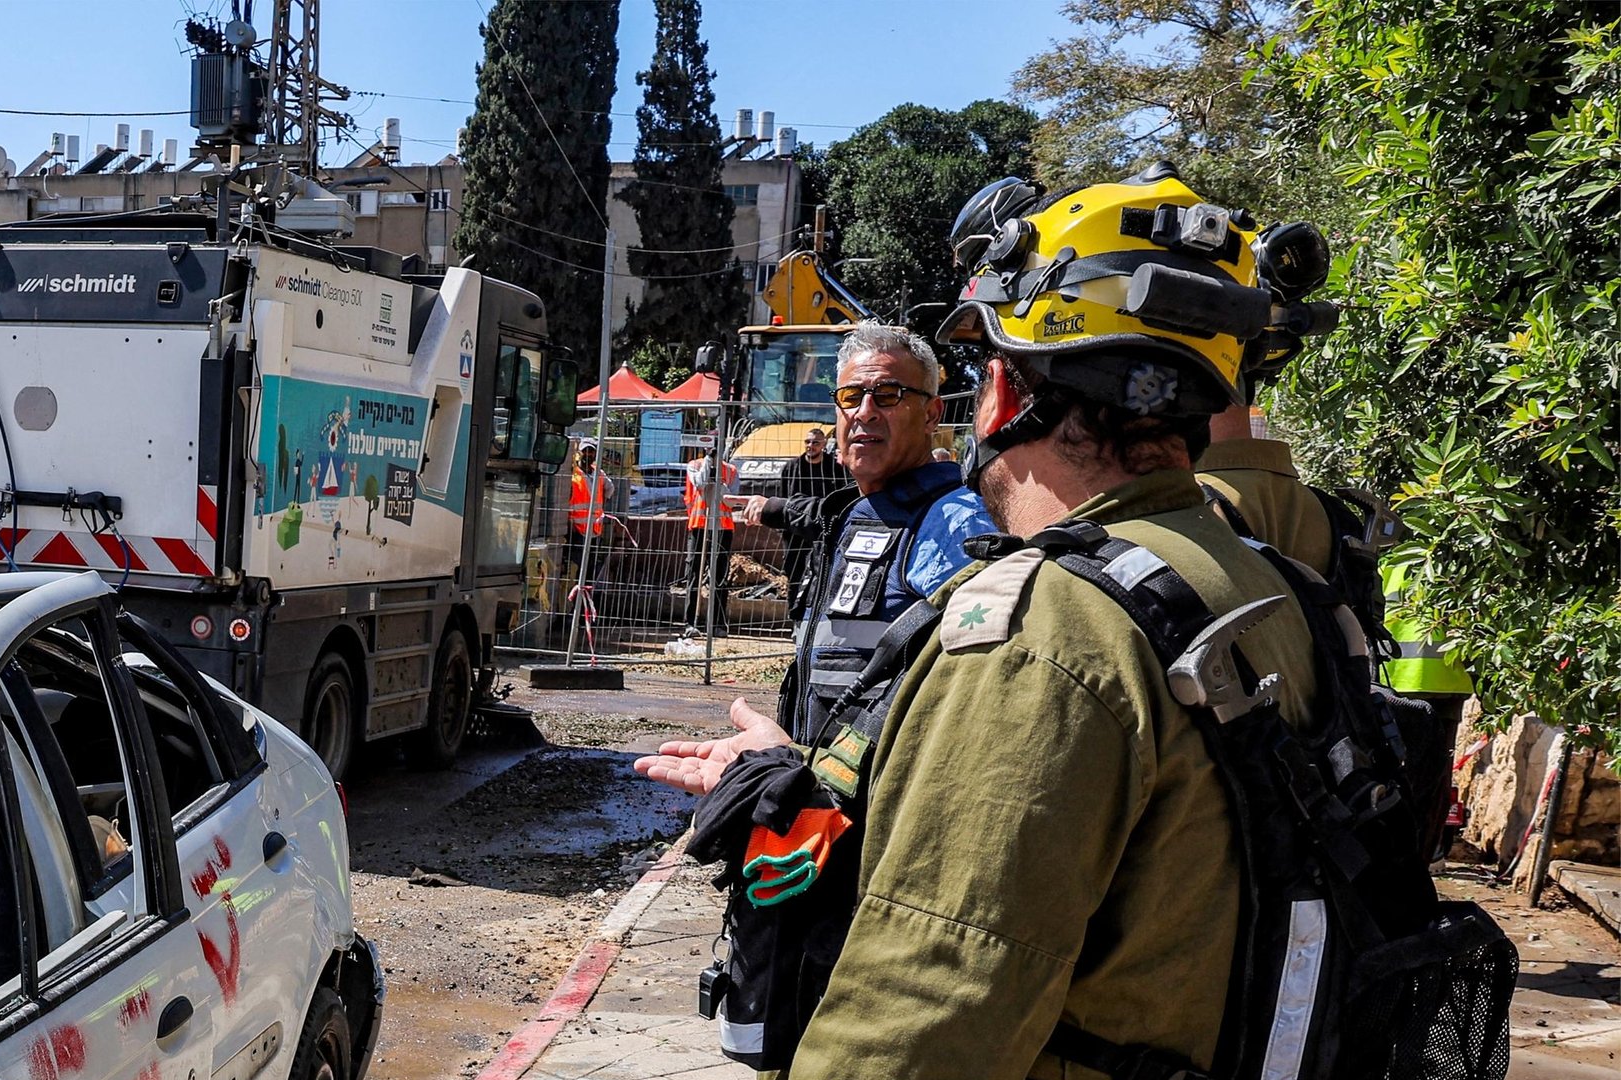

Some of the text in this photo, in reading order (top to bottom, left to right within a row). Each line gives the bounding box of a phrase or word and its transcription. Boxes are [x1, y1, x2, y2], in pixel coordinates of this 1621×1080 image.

[49, 273, 137, 293] schmidt
[288, 274, 321, 297] schmidt
[321, 281, 350, 307] Cleango
[1044, 317, 1084, 333] PACIFIC
[358, 399, 414, 428] בת-ים נקייה
[347, 428, 420, 459] זה בידיים שלנו!
